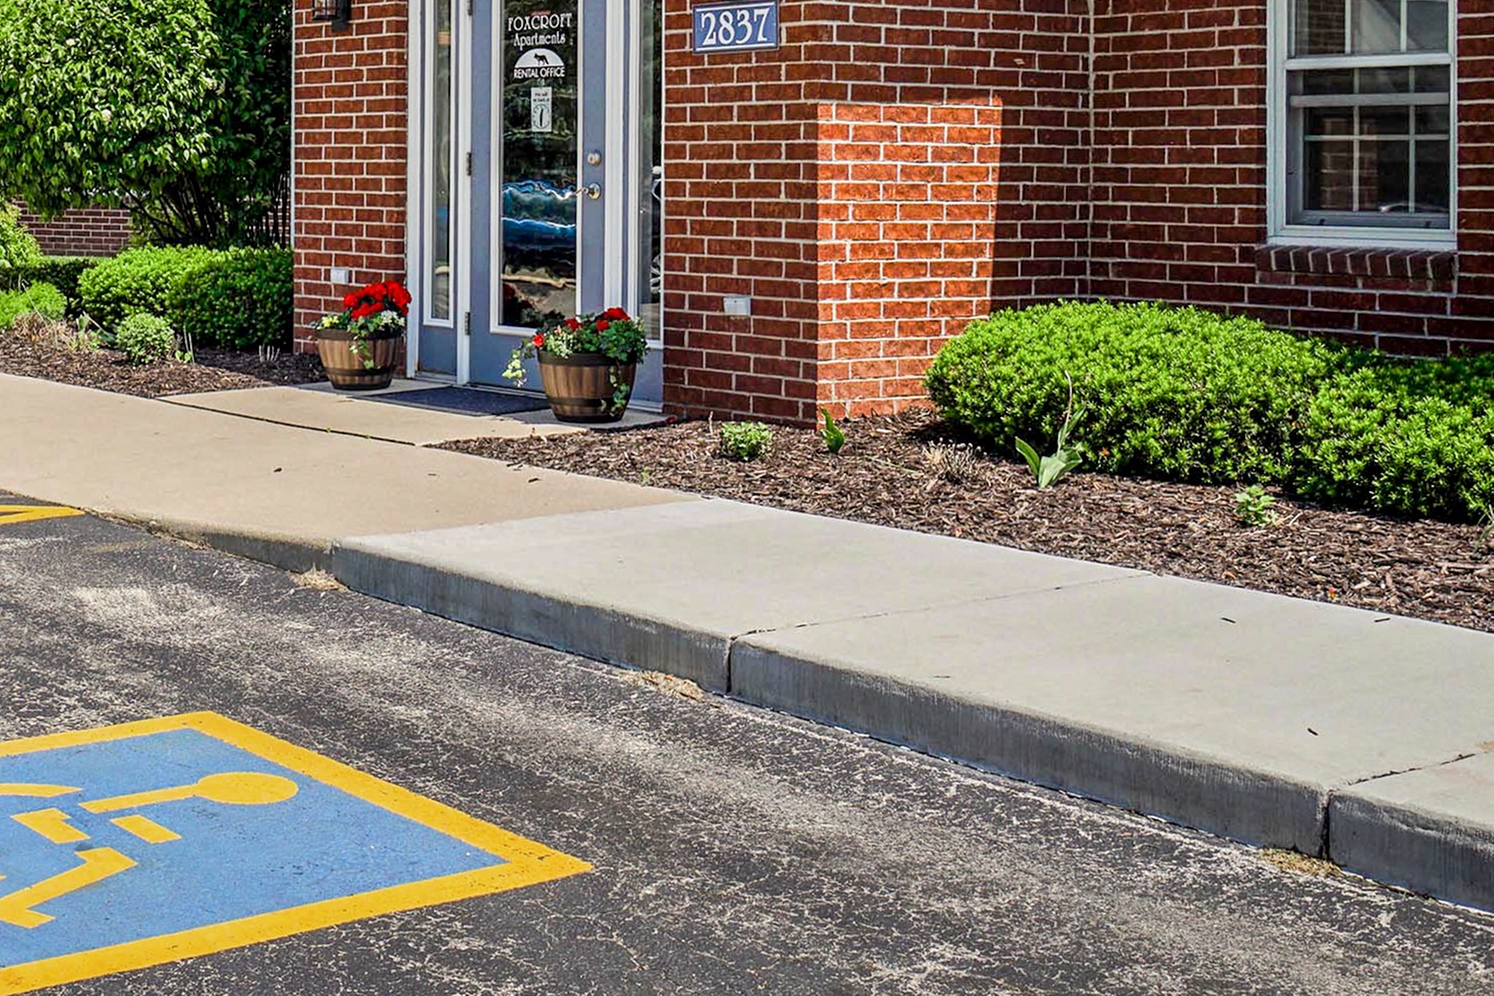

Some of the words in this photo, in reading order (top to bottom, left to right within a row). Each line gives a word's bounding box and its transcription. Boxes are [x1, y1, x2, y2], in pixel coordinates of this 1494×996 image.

[508, 13, 572, 31] FOXCROFT
[701, 8, 770, 46] 2837
[513, 31, 566, 50] Apartments
[513, 68, 539, 79] RENTAL
[539, 66, 566, 77] OFFICE
